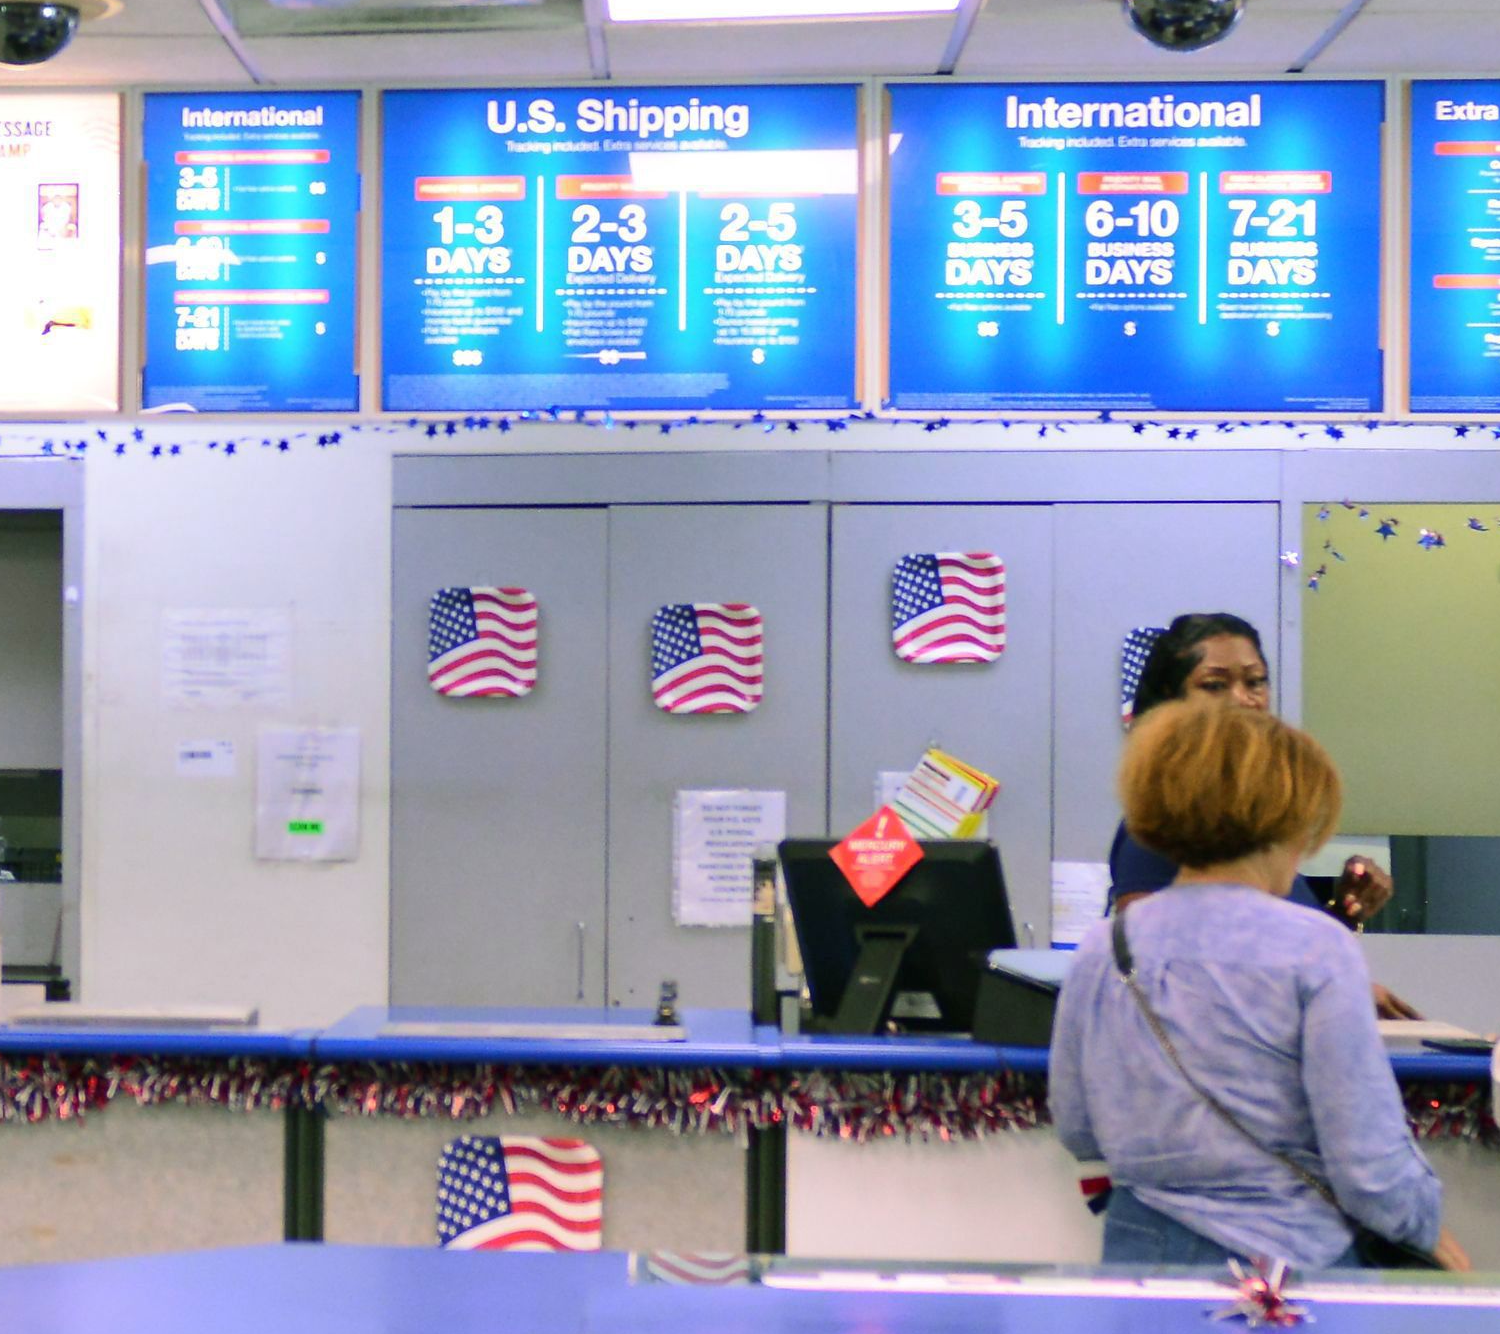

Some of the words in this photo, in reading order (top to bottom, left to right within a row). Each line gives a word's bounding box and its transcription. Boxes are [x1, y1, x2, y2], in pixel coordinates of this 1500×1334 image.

[182, 106, 323, 127] International
[487, 99, 566, 134] U.S.
[576, 98, 749, 138] Shipping
[1006, 94, 1261, 128] International
[1435, 101, 1499, 120] Extra
[433, 205, 504, 245] 1-3
[571, 204, 647, 243] 2-3
[720, 202, 796, 242] 2-5
[952, 200, 1028, 238] 3-5
[1086, 200, 1179, 237] 6-10
[1228, 199, 1316, 237] 7-21
[426, 246, 512, 274] DAYS
[568, 246, 654, 273] DAYS
[716, 244, 803, 272] DAYS
[1087, 242, 1174, 257] BUSINESS
[945, 259, 1033, 286] DAYS
[1085, 259, 1174, 286] DAYS
[1228, 258, 1317, 286] DAYS
